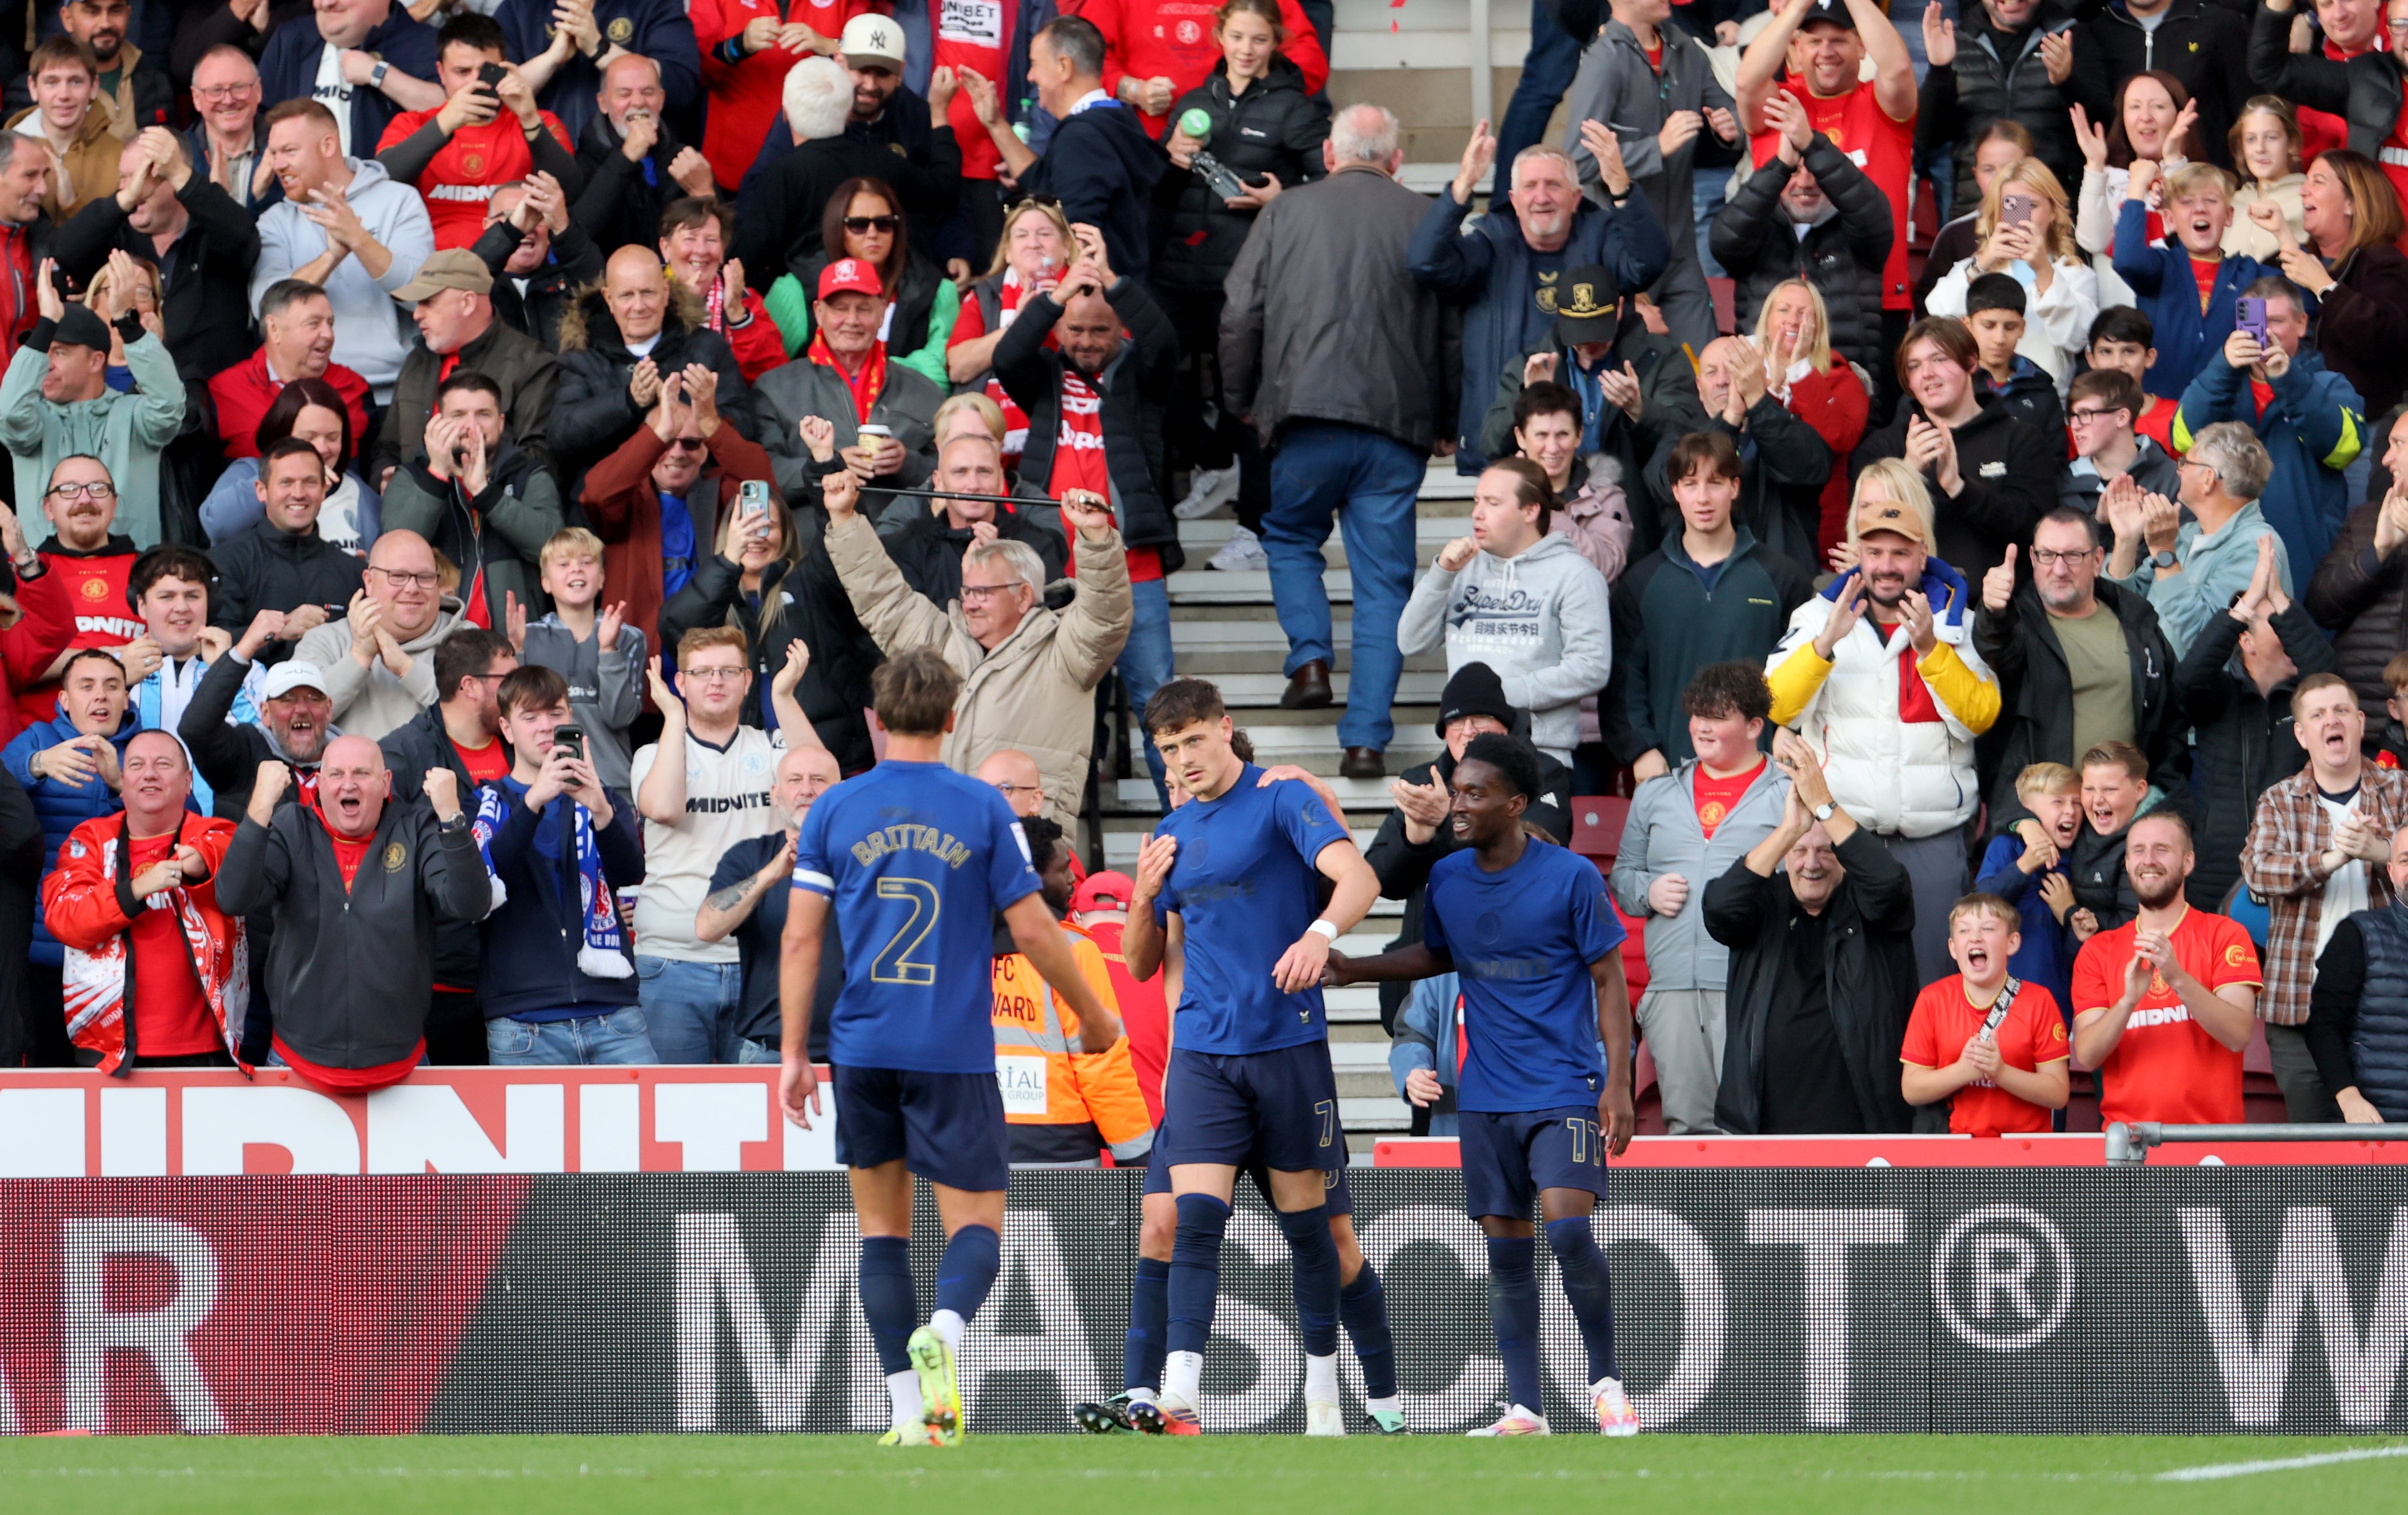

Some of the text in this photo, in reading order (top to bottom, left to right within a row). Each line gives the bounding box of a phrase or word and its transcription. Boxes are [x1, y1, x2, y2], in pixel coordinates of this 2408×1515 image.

[685, 791, 770, 813] MIDNITE
[850, 823, 972, 870] BRITTAIN
[870, 877, 941, 986] 2
[2126, 1004, 2194, 1030] IDNI
[1008, 1091, 1045, 1101] GROUP
[1315, 1099, 1334, 1147] 7
[1567, 1117, 1602, 1166] 11
[0, 1215, 231, 1435] R
